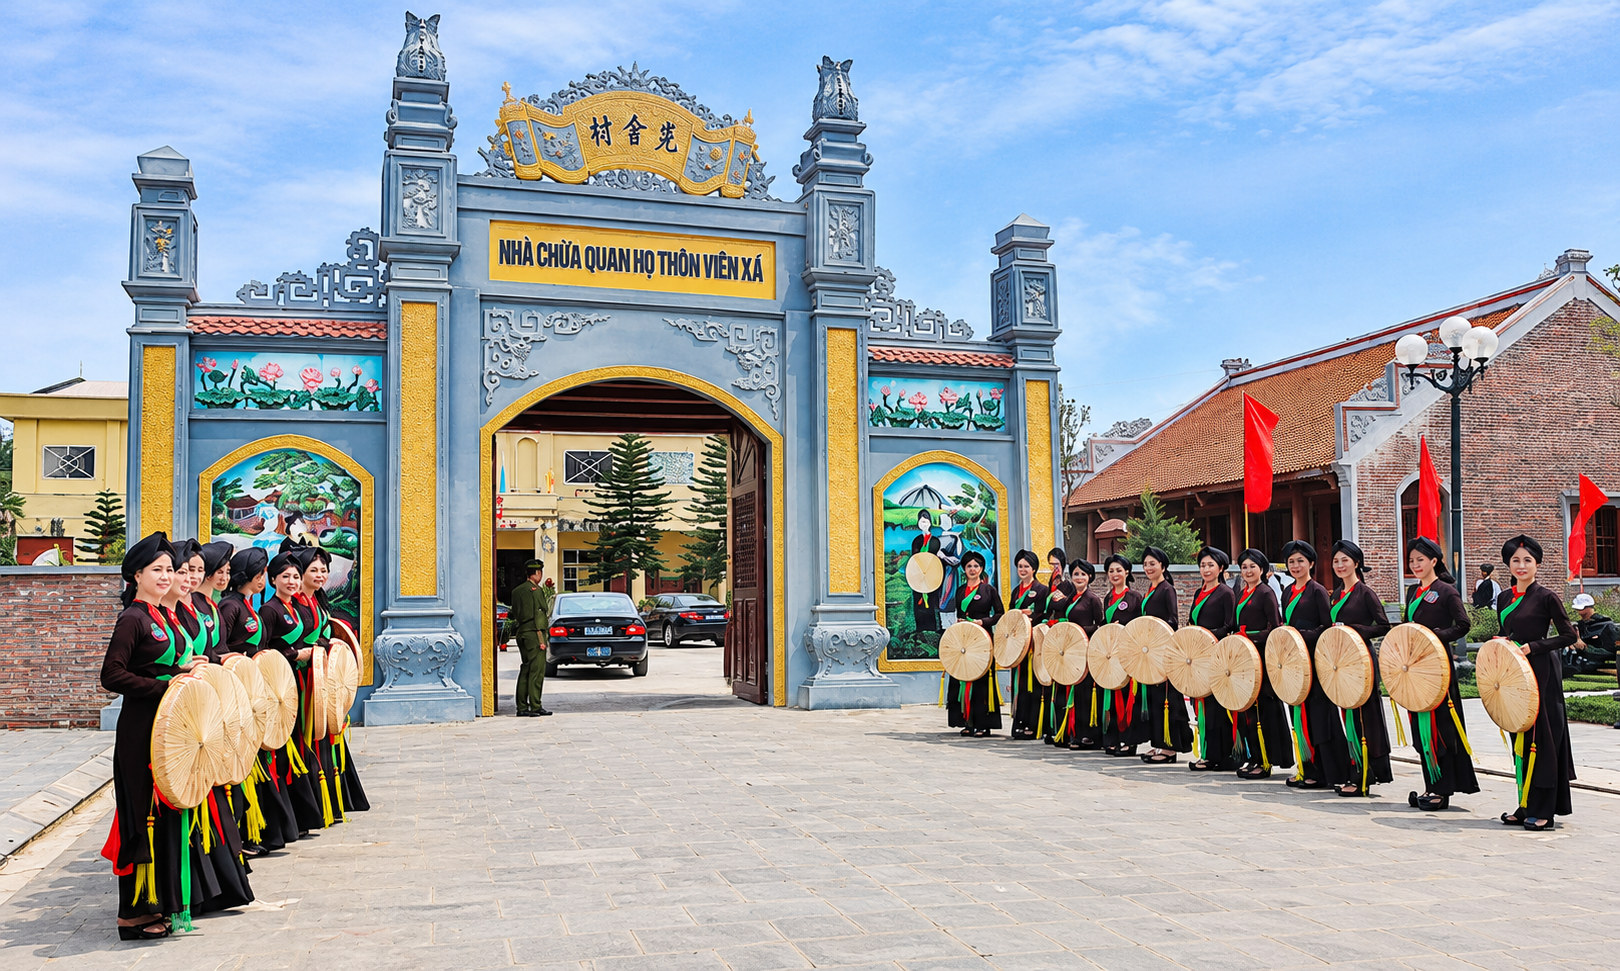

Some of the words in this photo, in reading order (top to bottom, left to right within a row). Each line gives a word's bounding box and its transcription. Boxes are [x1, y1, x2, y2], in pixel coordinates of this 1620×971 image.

[499, 237, 534, 267] NHÀ
[584, 245, 631, 274] QUAN
[633, 248, 655, 279] HỌ
[656, 247, 701, 278] THÔN
[702, 250, 739, 280] VIÊN
[740, 253, 764, 282] XÁ
